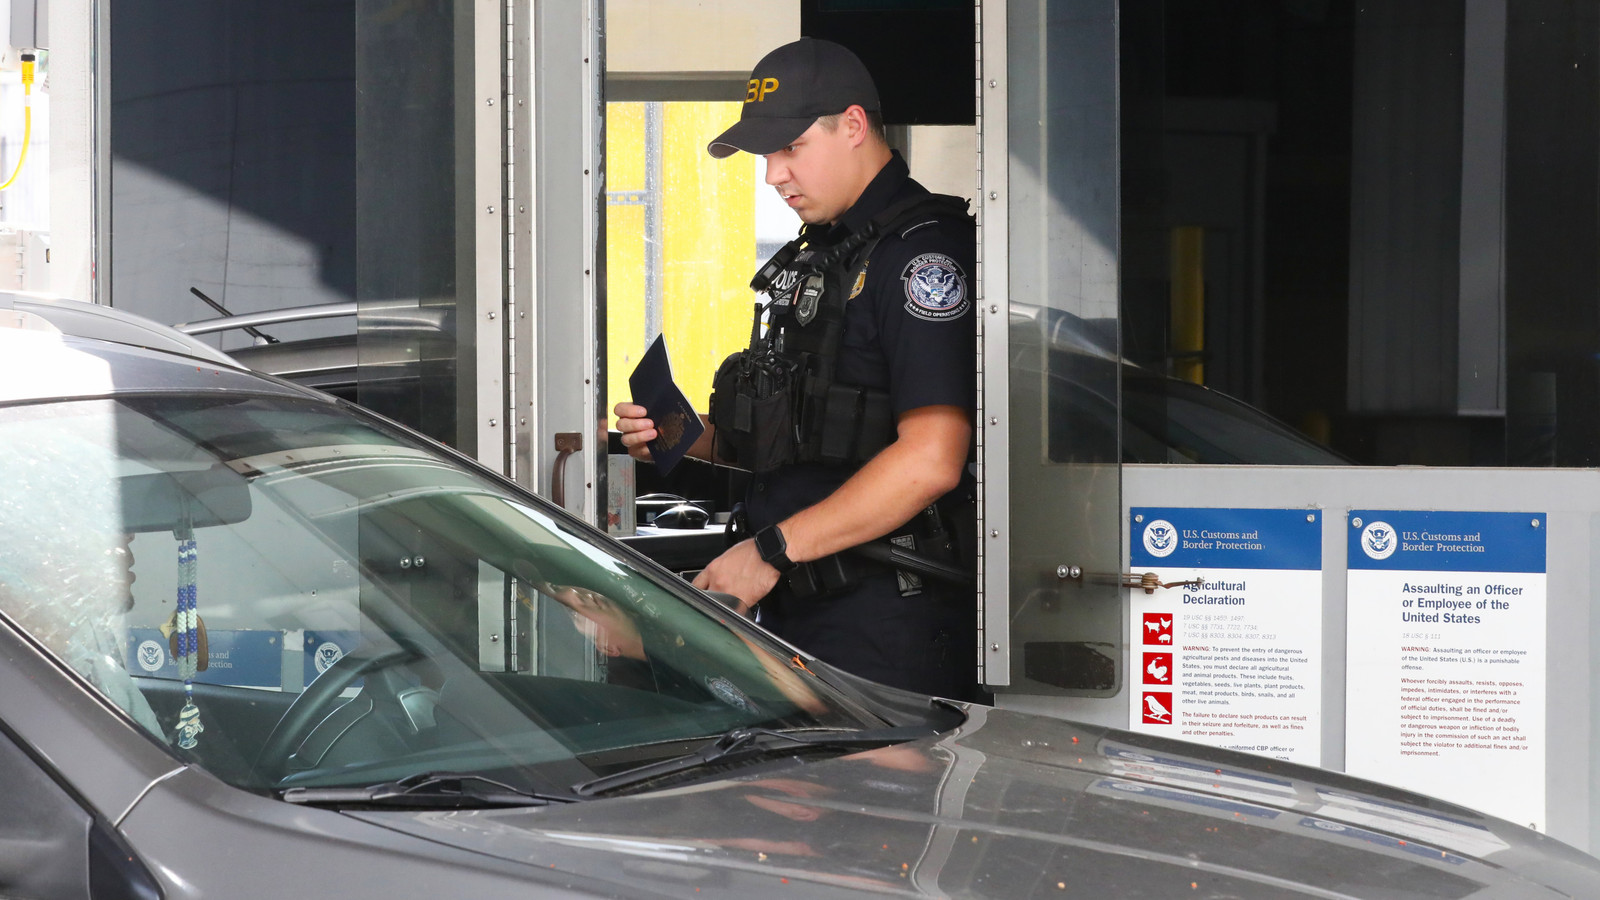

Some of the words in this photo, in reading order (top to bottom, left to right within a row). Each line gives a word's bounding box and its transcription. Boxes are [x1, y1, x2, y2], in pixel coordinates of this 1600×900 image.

[745, 78, 779, 103] BP
[1183, 530, 1199, 538] U.S.
[1201, 530, 1240, 539] Customs
[1241, 530, 1258, 540] and
[1402, 532, 1420, 541] U.S.
[1421, 532, 1461, 542] Customs
[1463, 532, 1480, 542] and
[1183, 540, 1213, 549] Border
[1216, 541, 1262, 550] Protection
[1402, 542, 1434, 551] Border
[1437, 543, 1485, 552] Protection
[1402, 583, 1463, 597] Assaulting
[1467, 586, 1480, 594] an
[1485, 584, 1523, 595] Officer
[1183, 594, 1245, 606] Declaration
[1402, 600, 1414, 608] or
[1418, 598, 1472, 611] Employee
[1476, 599, 1487, 609] of
[1491, 599, 1509, 610] the
[1402, 612, 1439, 623] United
[1443, 613, 1480, 624] States
